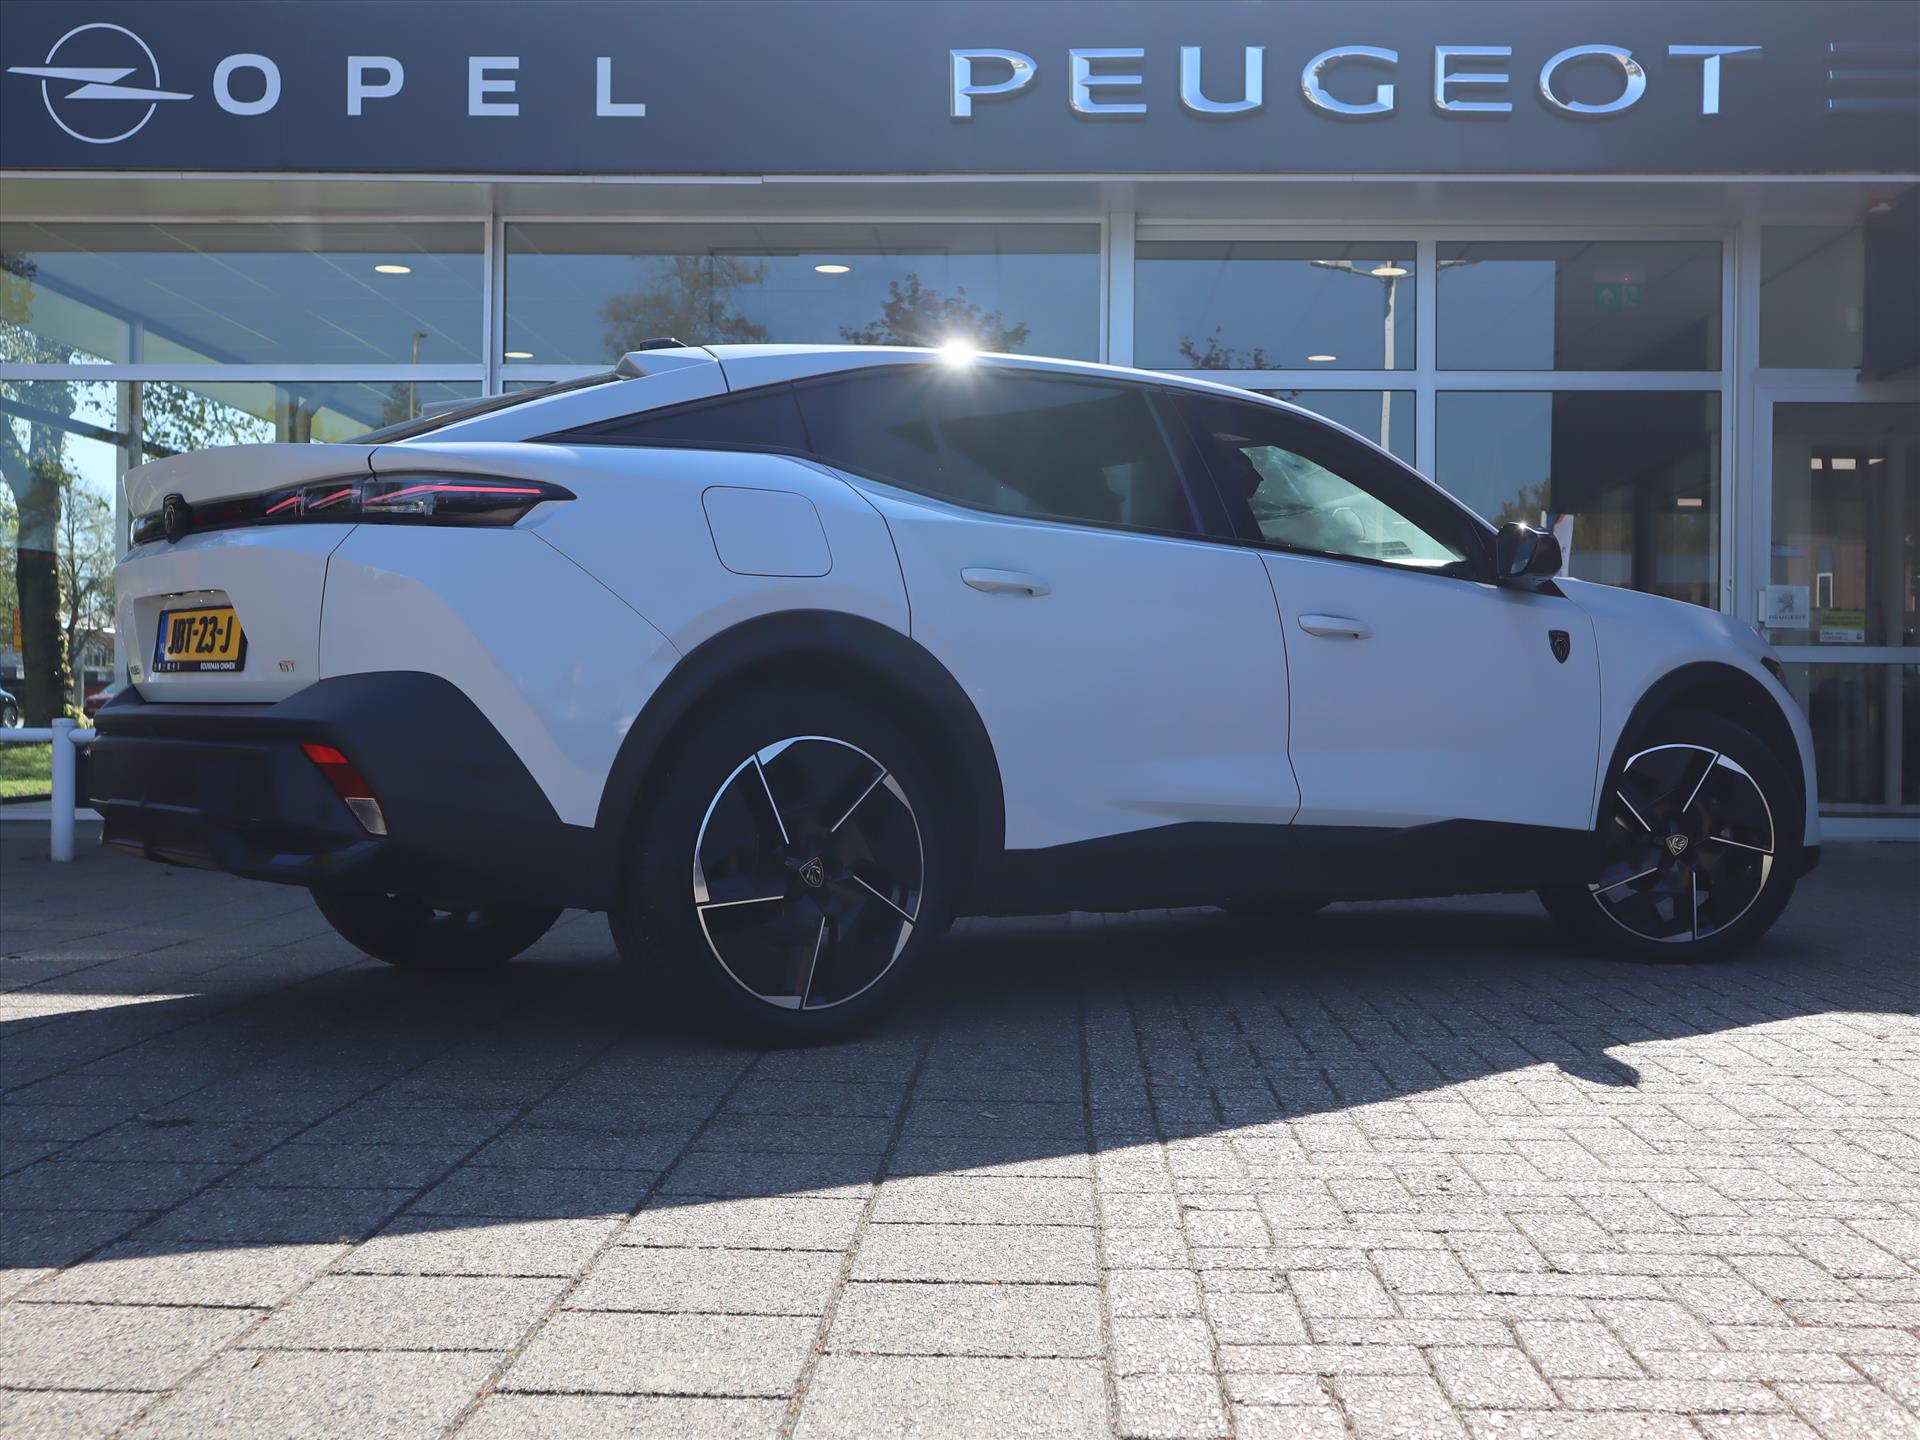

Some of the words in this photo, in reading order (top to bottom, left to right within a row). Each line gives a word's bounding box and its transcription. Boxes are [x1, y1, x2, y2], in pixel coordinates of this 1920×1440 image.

[213, 53, 646, 117] OPEL
[949, 44, 1763, 119] PEUGEOT
[168, 616, 233, 654] JBT-23-J
